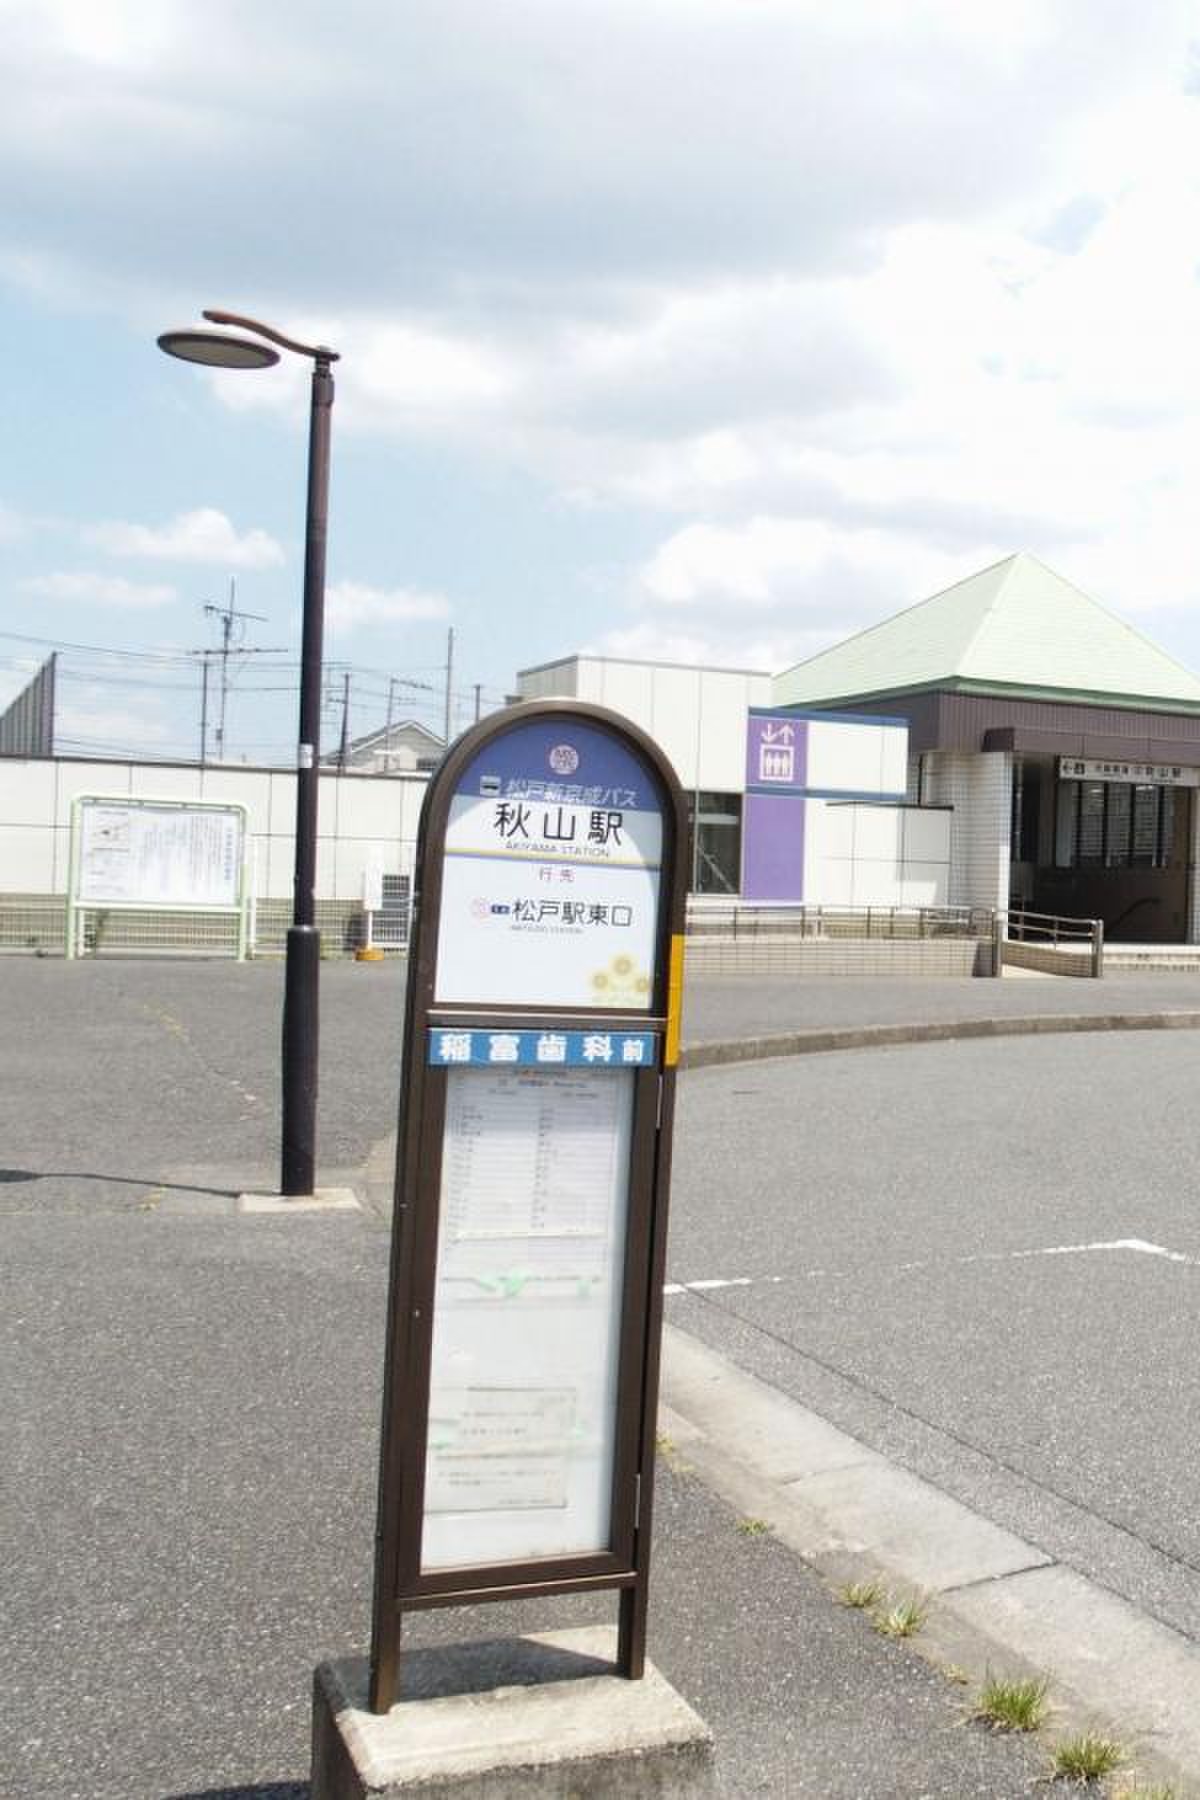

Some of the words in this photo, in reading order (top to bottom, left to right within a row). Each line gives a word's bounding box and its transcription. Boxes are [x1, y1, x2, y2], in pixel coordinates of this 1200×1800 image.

[506, 778, 640, 807] 松戸新京成バス
[494, 803, 623, 846] 秋山駅
[561, 846, 610, 857] STATION
[512, 899, 633, 926] 松戸駅東口
